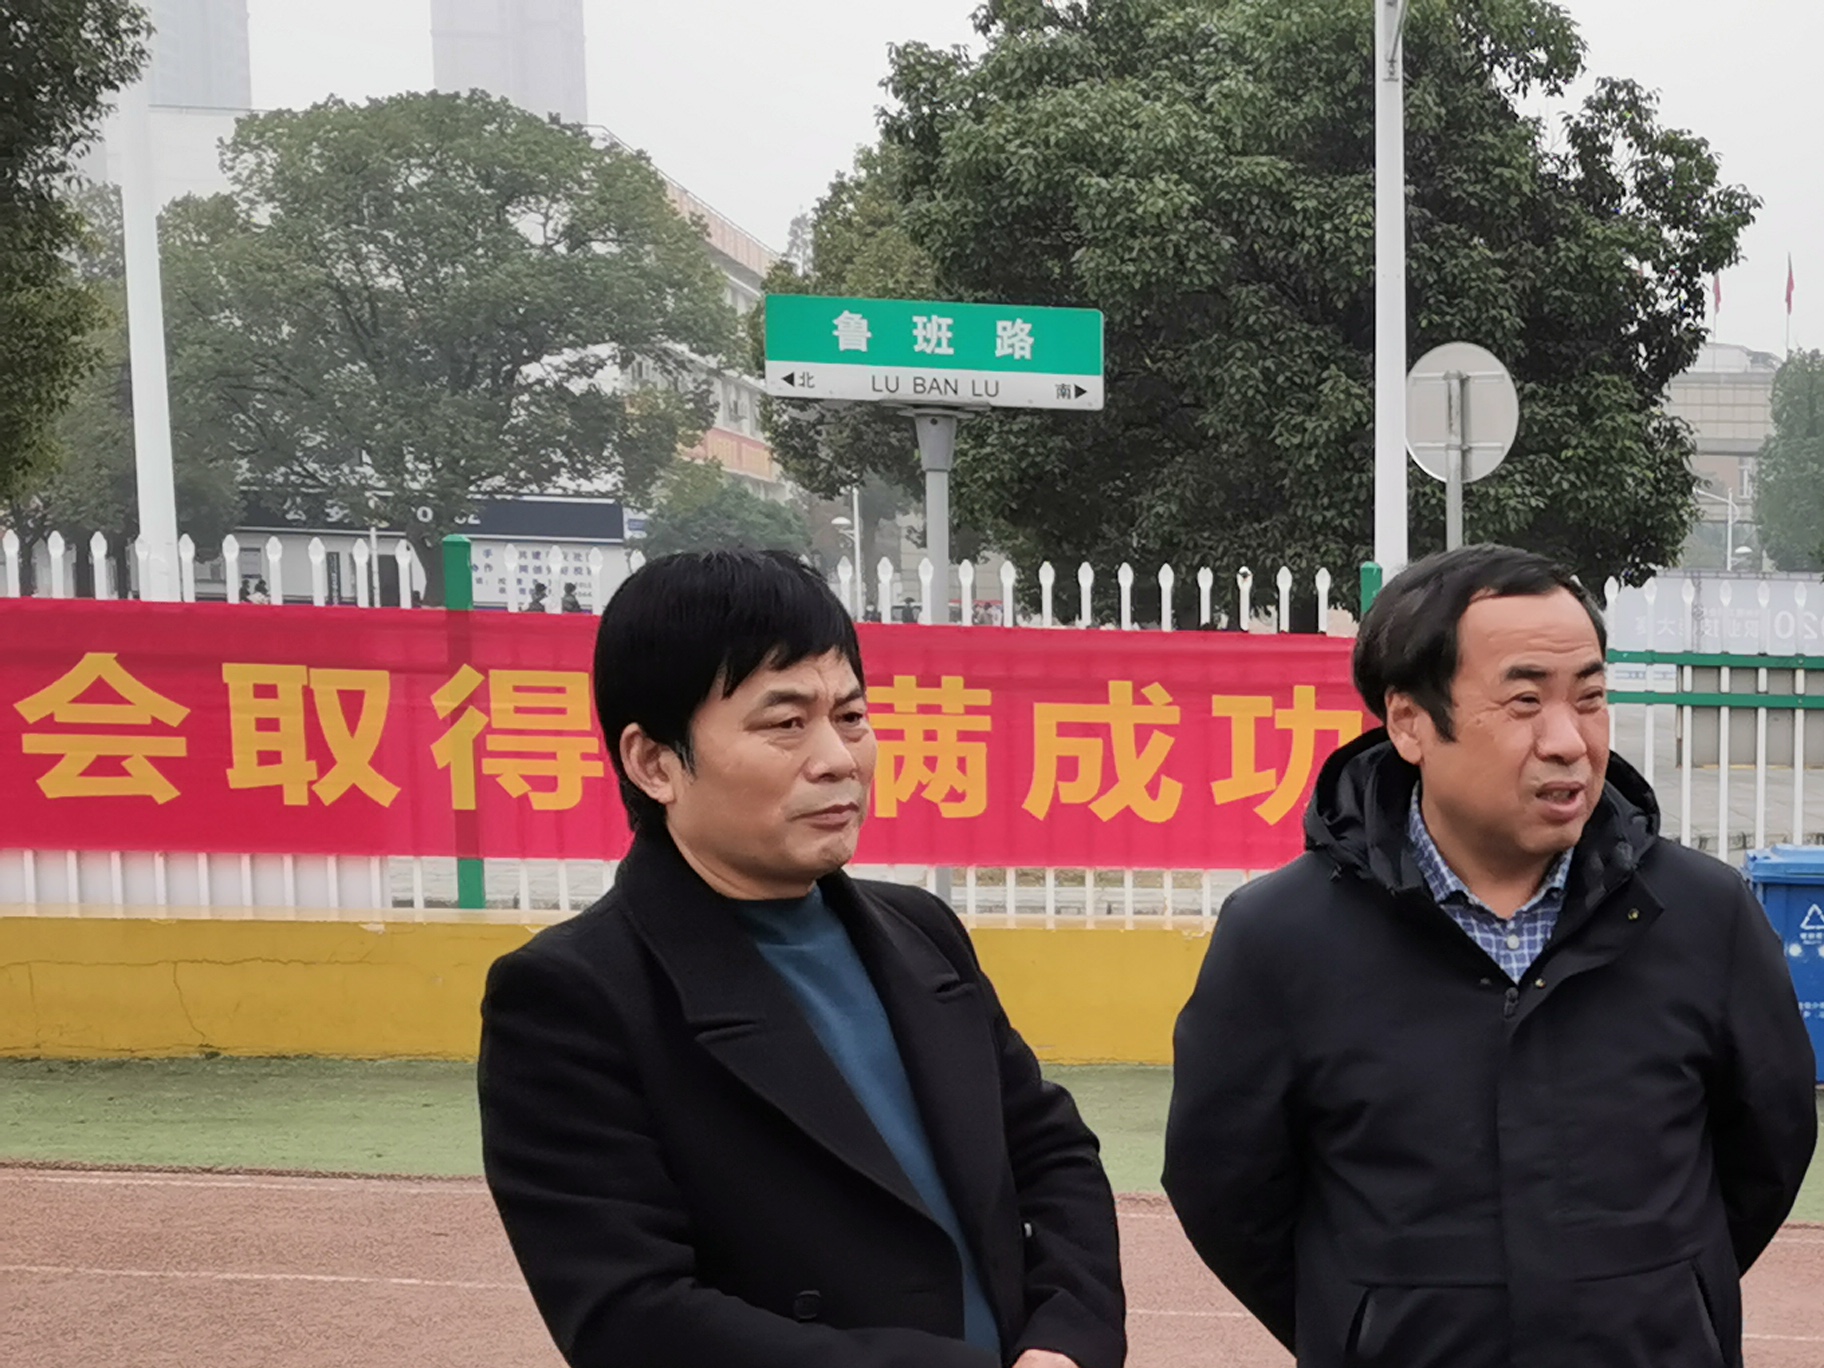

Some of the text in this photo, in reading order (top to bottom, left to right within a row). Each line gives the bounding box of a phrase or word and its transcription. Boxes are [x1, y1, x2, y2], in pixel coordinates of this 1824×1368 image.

[831, 310, 1035, 360] 鲁班路
[798, 371, 815, 389] 北
[871, 374, 1000, 398] LU BAN LU
[1055, 383, 1072, 400] 南
